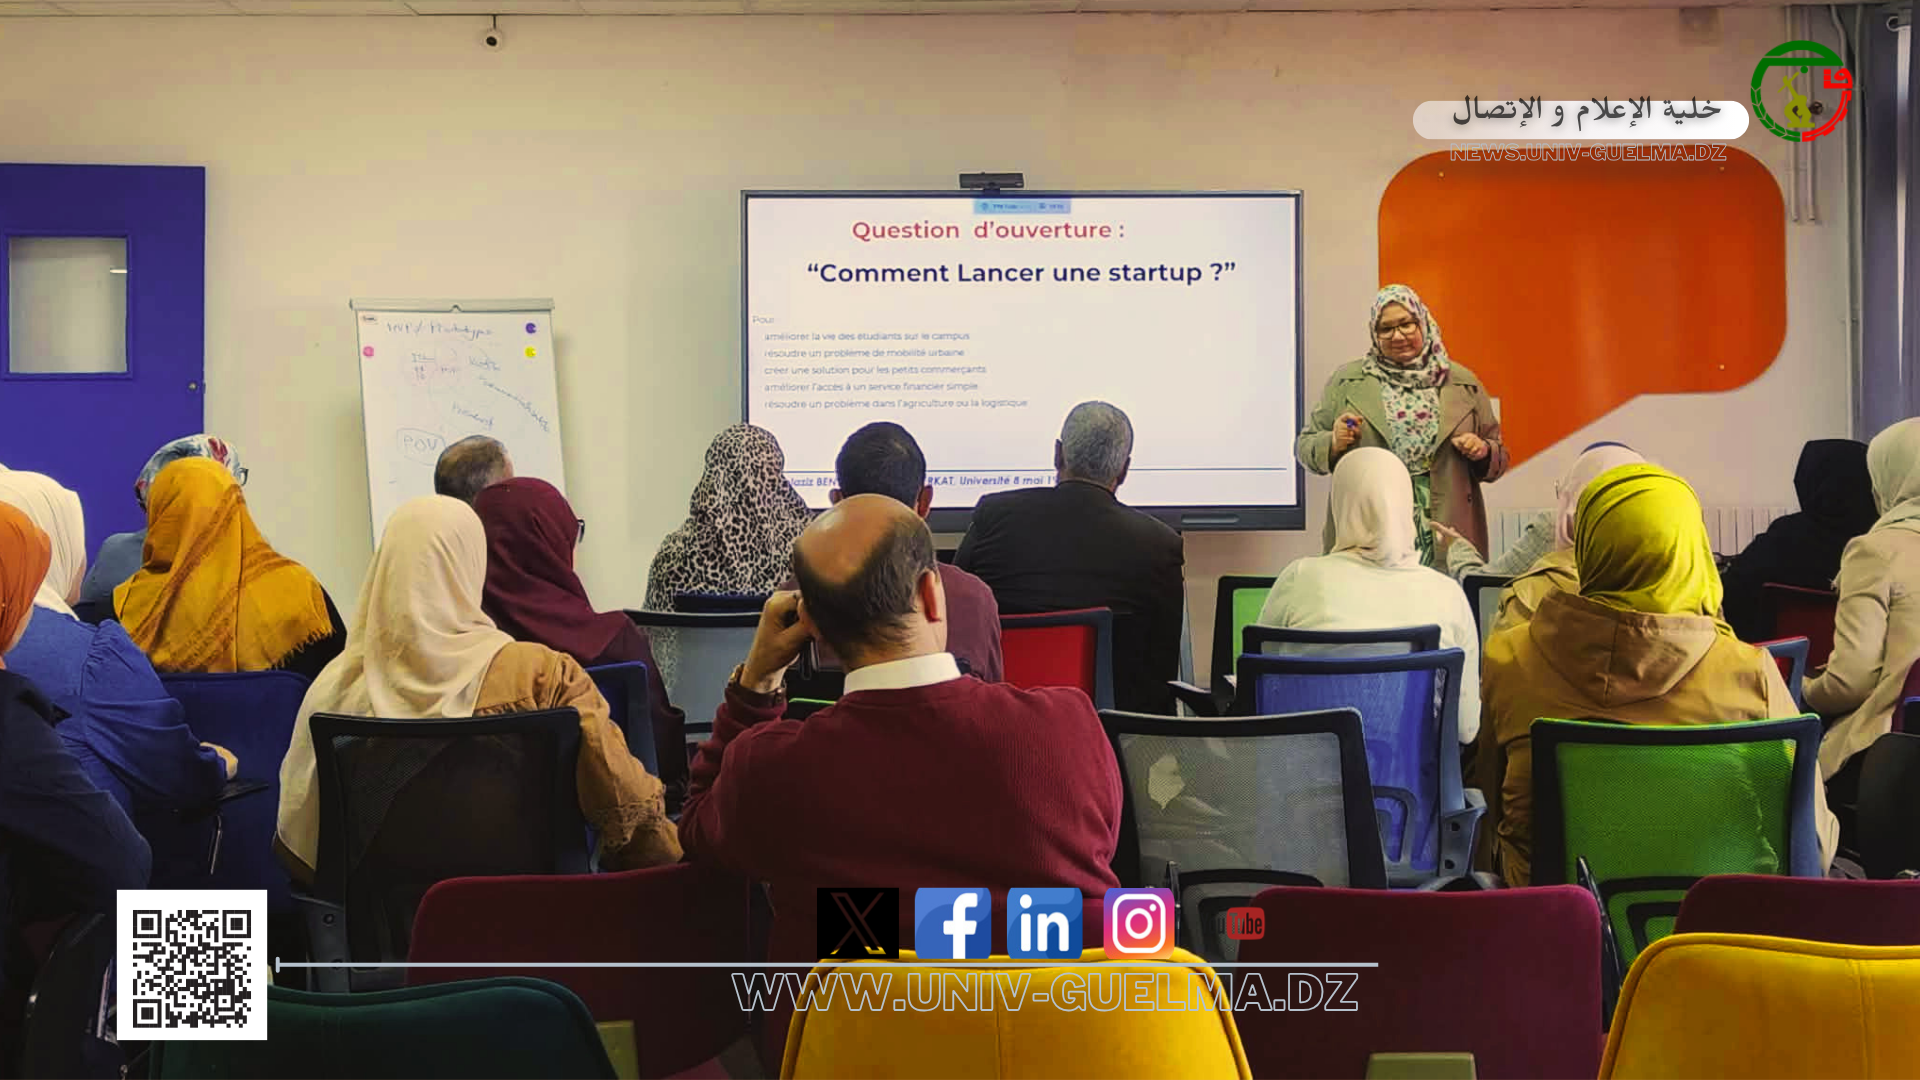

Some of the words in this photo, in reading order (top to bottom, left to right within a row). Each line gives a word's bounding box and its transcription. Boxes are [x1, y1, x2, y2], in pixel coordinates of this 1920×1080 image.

[852, 219, 960, 243] Question
[958, 263, 1045, 283] Lancer
[1053, 267, 1101, 283] une
[1108, 263, 1203, 287] startup
[812, 332, 821, 341] la
[821, 332, 836, 341] vie
[838, 332, 856, 341] des
[904, 333, 919, 341] sur
[921, 332, 930, 341] le
[931, 333, 970, 342] campus
[808, 350, 822, 358] un
[872, 348, 885, 358] de
[887, 348, 926, 357] mobilité
[928, 348, 965, 358] urbaine
[791, 367, 810, 375] une
[811, 365, 850, 375] solution
[851, 367, 874, 376] pour
[876, 365, 890, 375] les
[891, 365, 919, 376] petits
[920, 365, 988, 376] commerçants
[853, 384, 867, 392] un
[868, 384, 902, 392] service
[903, 382, 945, 392] financier
[946, 382, 979, 393] simple
[808, 401, 822, 409] un
[872, 399, 896, 408] dans
[955, 400, 970, 408] ou
[970, 399, 980, 408] la
[980, 398, 1028, 410] logistique
[816, 477, 837, 487] BEN
[959, 475, 1011, 486] Université
[1013, 476, 1020, 486] 8
[1022, 475, 1044, 486] mai
